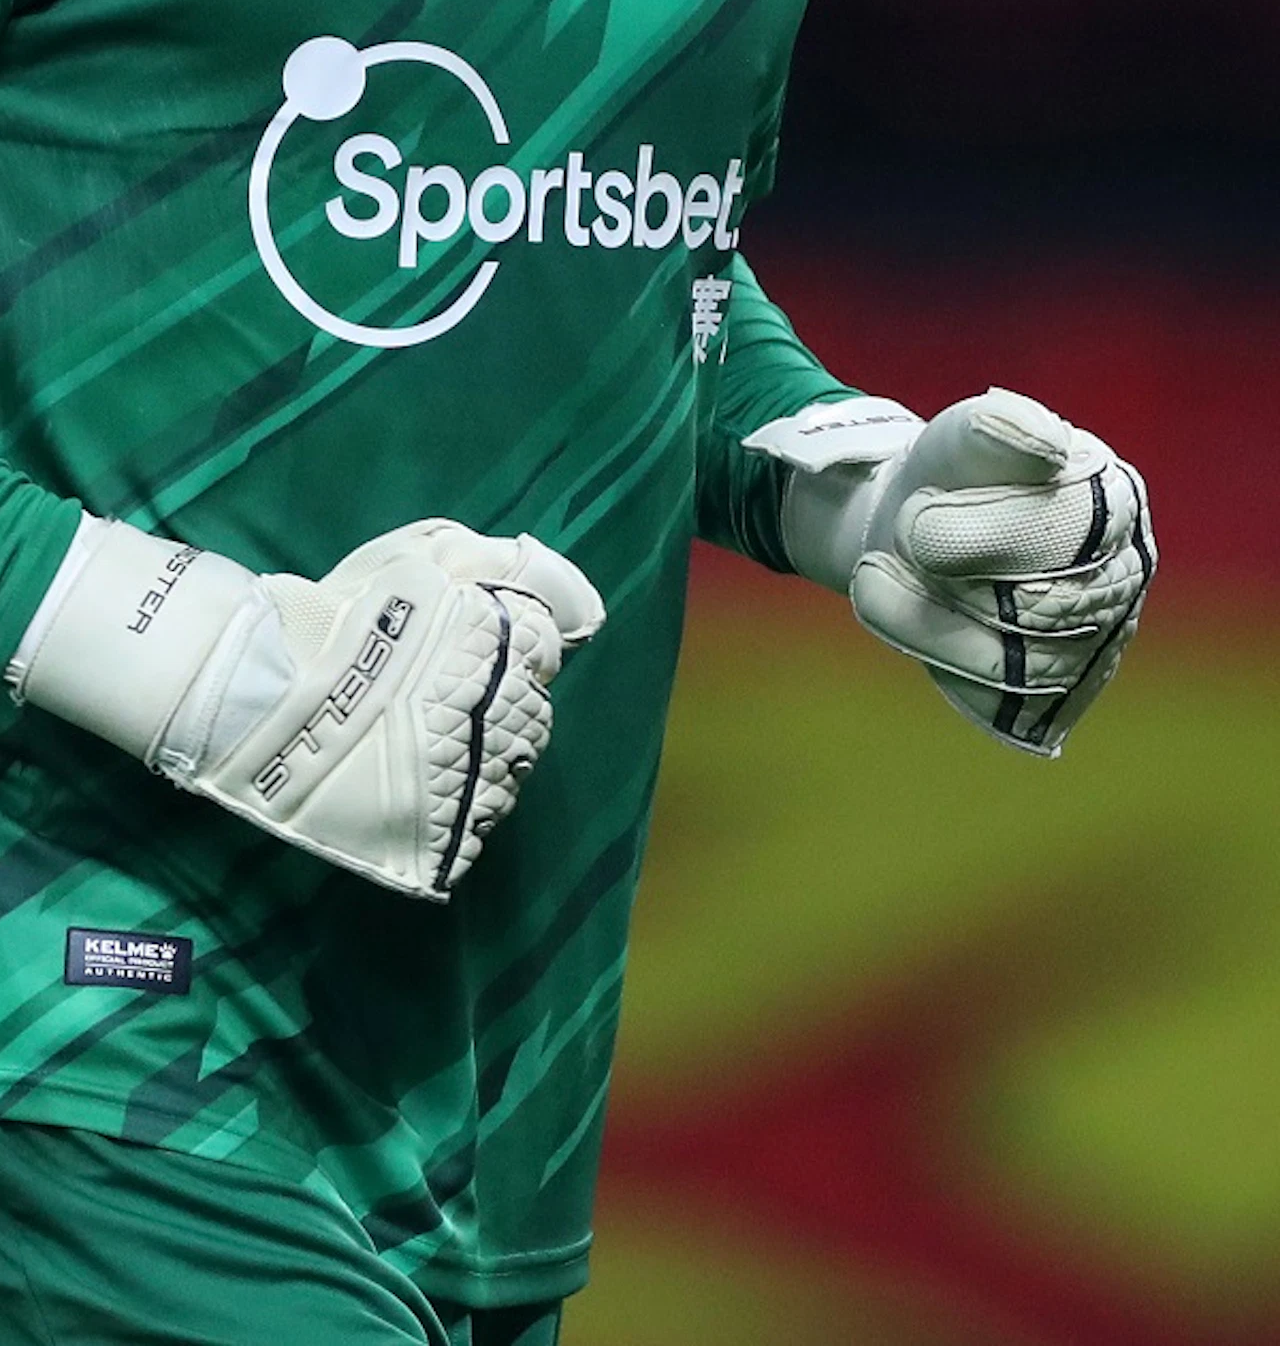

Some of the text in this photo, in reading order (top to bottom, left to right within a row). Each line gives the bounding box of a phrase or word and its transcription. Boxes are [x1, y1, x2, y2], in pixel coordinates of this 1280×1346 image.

[798, 415, 914, 435] OSTER
[127, 545, 204, 634] OSTER
[253, 631, 393, 803] SELLS
[84, 937, 159, 959] KELME
[84, 967, 173, 983] AUTHENTIC
